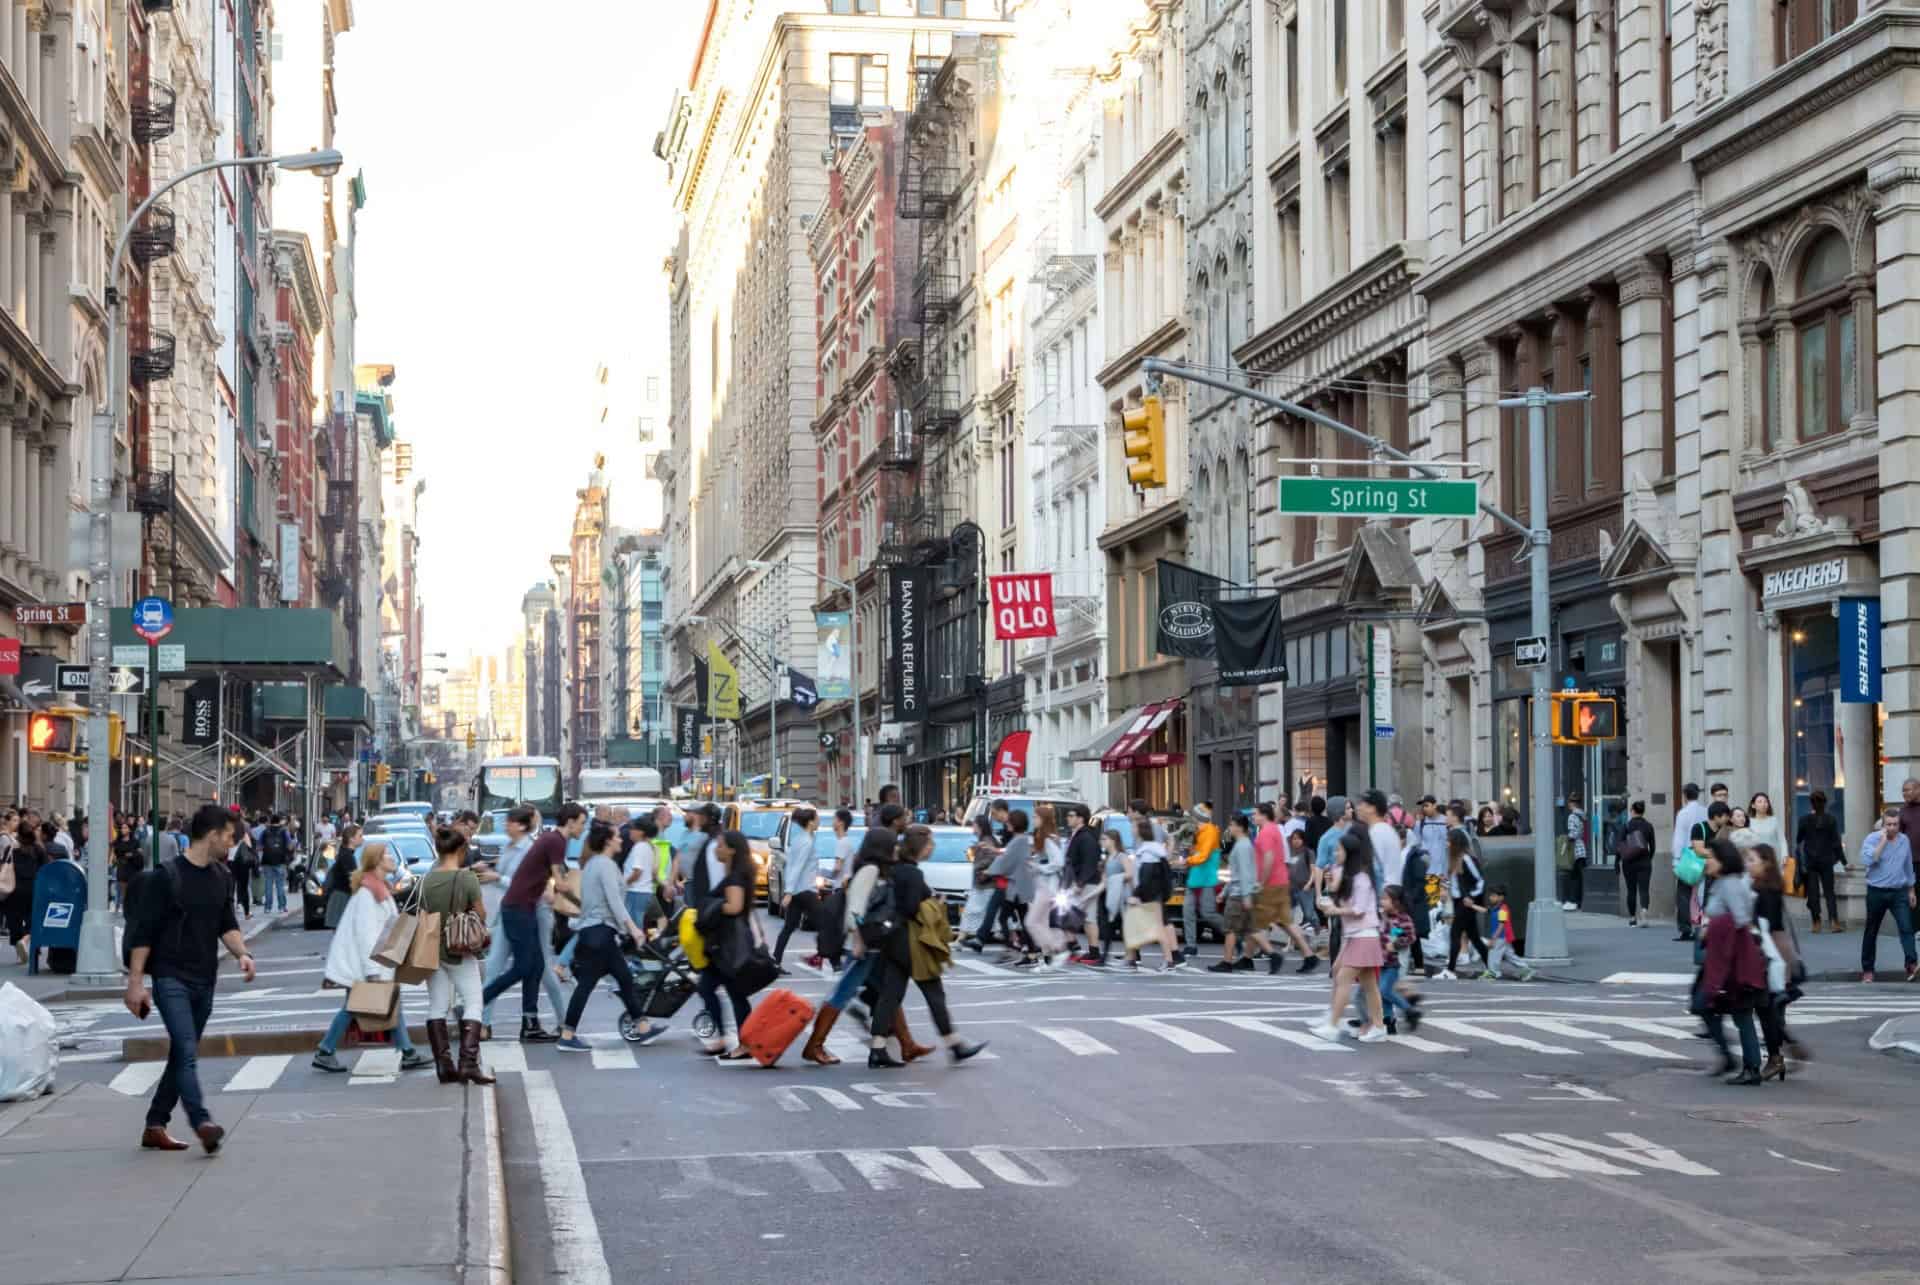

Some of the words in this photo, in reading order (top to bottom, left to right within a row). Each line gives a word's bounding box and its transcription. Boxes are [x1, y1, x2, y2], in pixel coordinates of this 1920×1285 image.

[1330, 486, 1398, 512] Spring
[1408, 488, 1427, 508] St
[1765, 559, 1841, 595] SKECHERS
[997, 579, 1041, 604] UNI
[16, 606, 53, 624] Spring
[58, 606, 69, 620] St
[901, 580, 913, 639] BANANA
[1000, 606, 1048, 634] QLO
[1169, 604, 1203, 617] STEVE
[1167, 621, 1211, 636] MADDEN
[1857, 601, 1869, 696] SKECHERS
[70, 673, 88, 684] ON
[902, 643, 915, 710] REPUBLIC
[1222, 670, 1245, 678] CLUB
[1246, 665, 1285, 677] MONACO
[194, 700, 208, 737] BOSS
